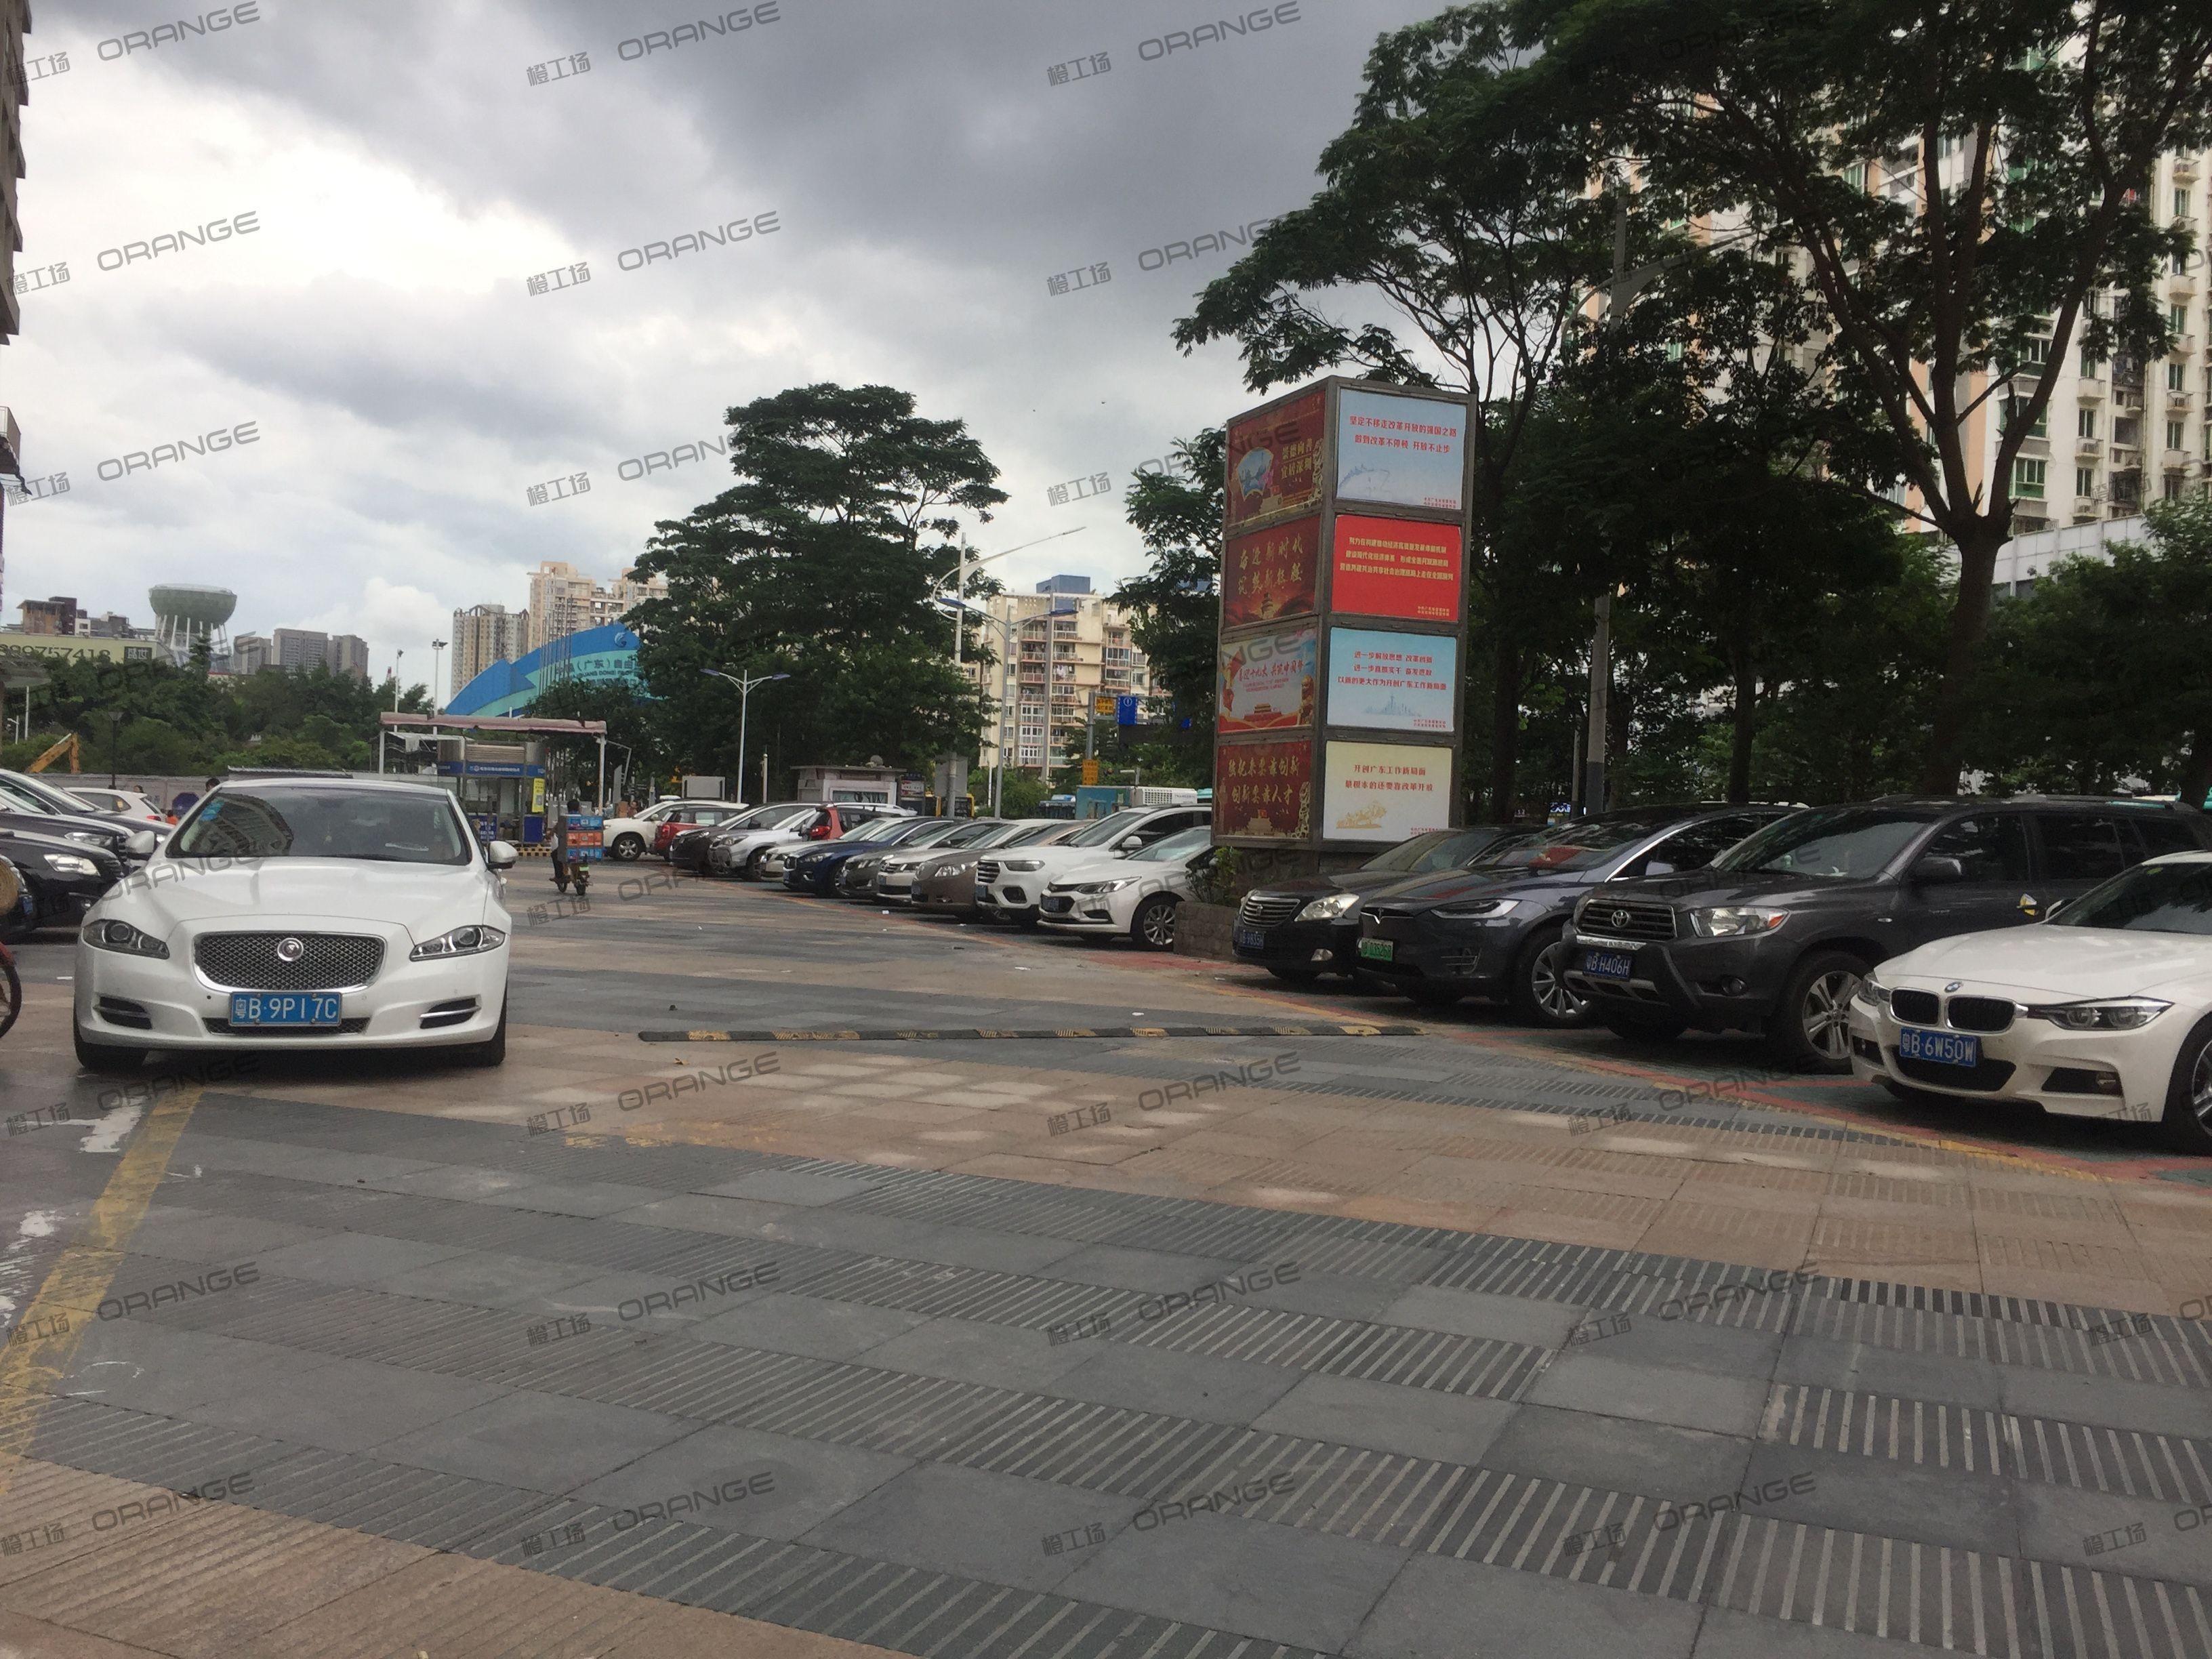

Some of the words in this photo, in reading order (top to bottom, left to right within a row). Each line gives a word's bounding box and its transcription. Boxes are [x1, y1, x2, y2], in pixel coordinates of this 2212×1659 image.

[1349, 415, 1456, 437] 坚定不移走改革开放的强国之路
[1353, 764, 1426, 776] 开创广东工作新局面
